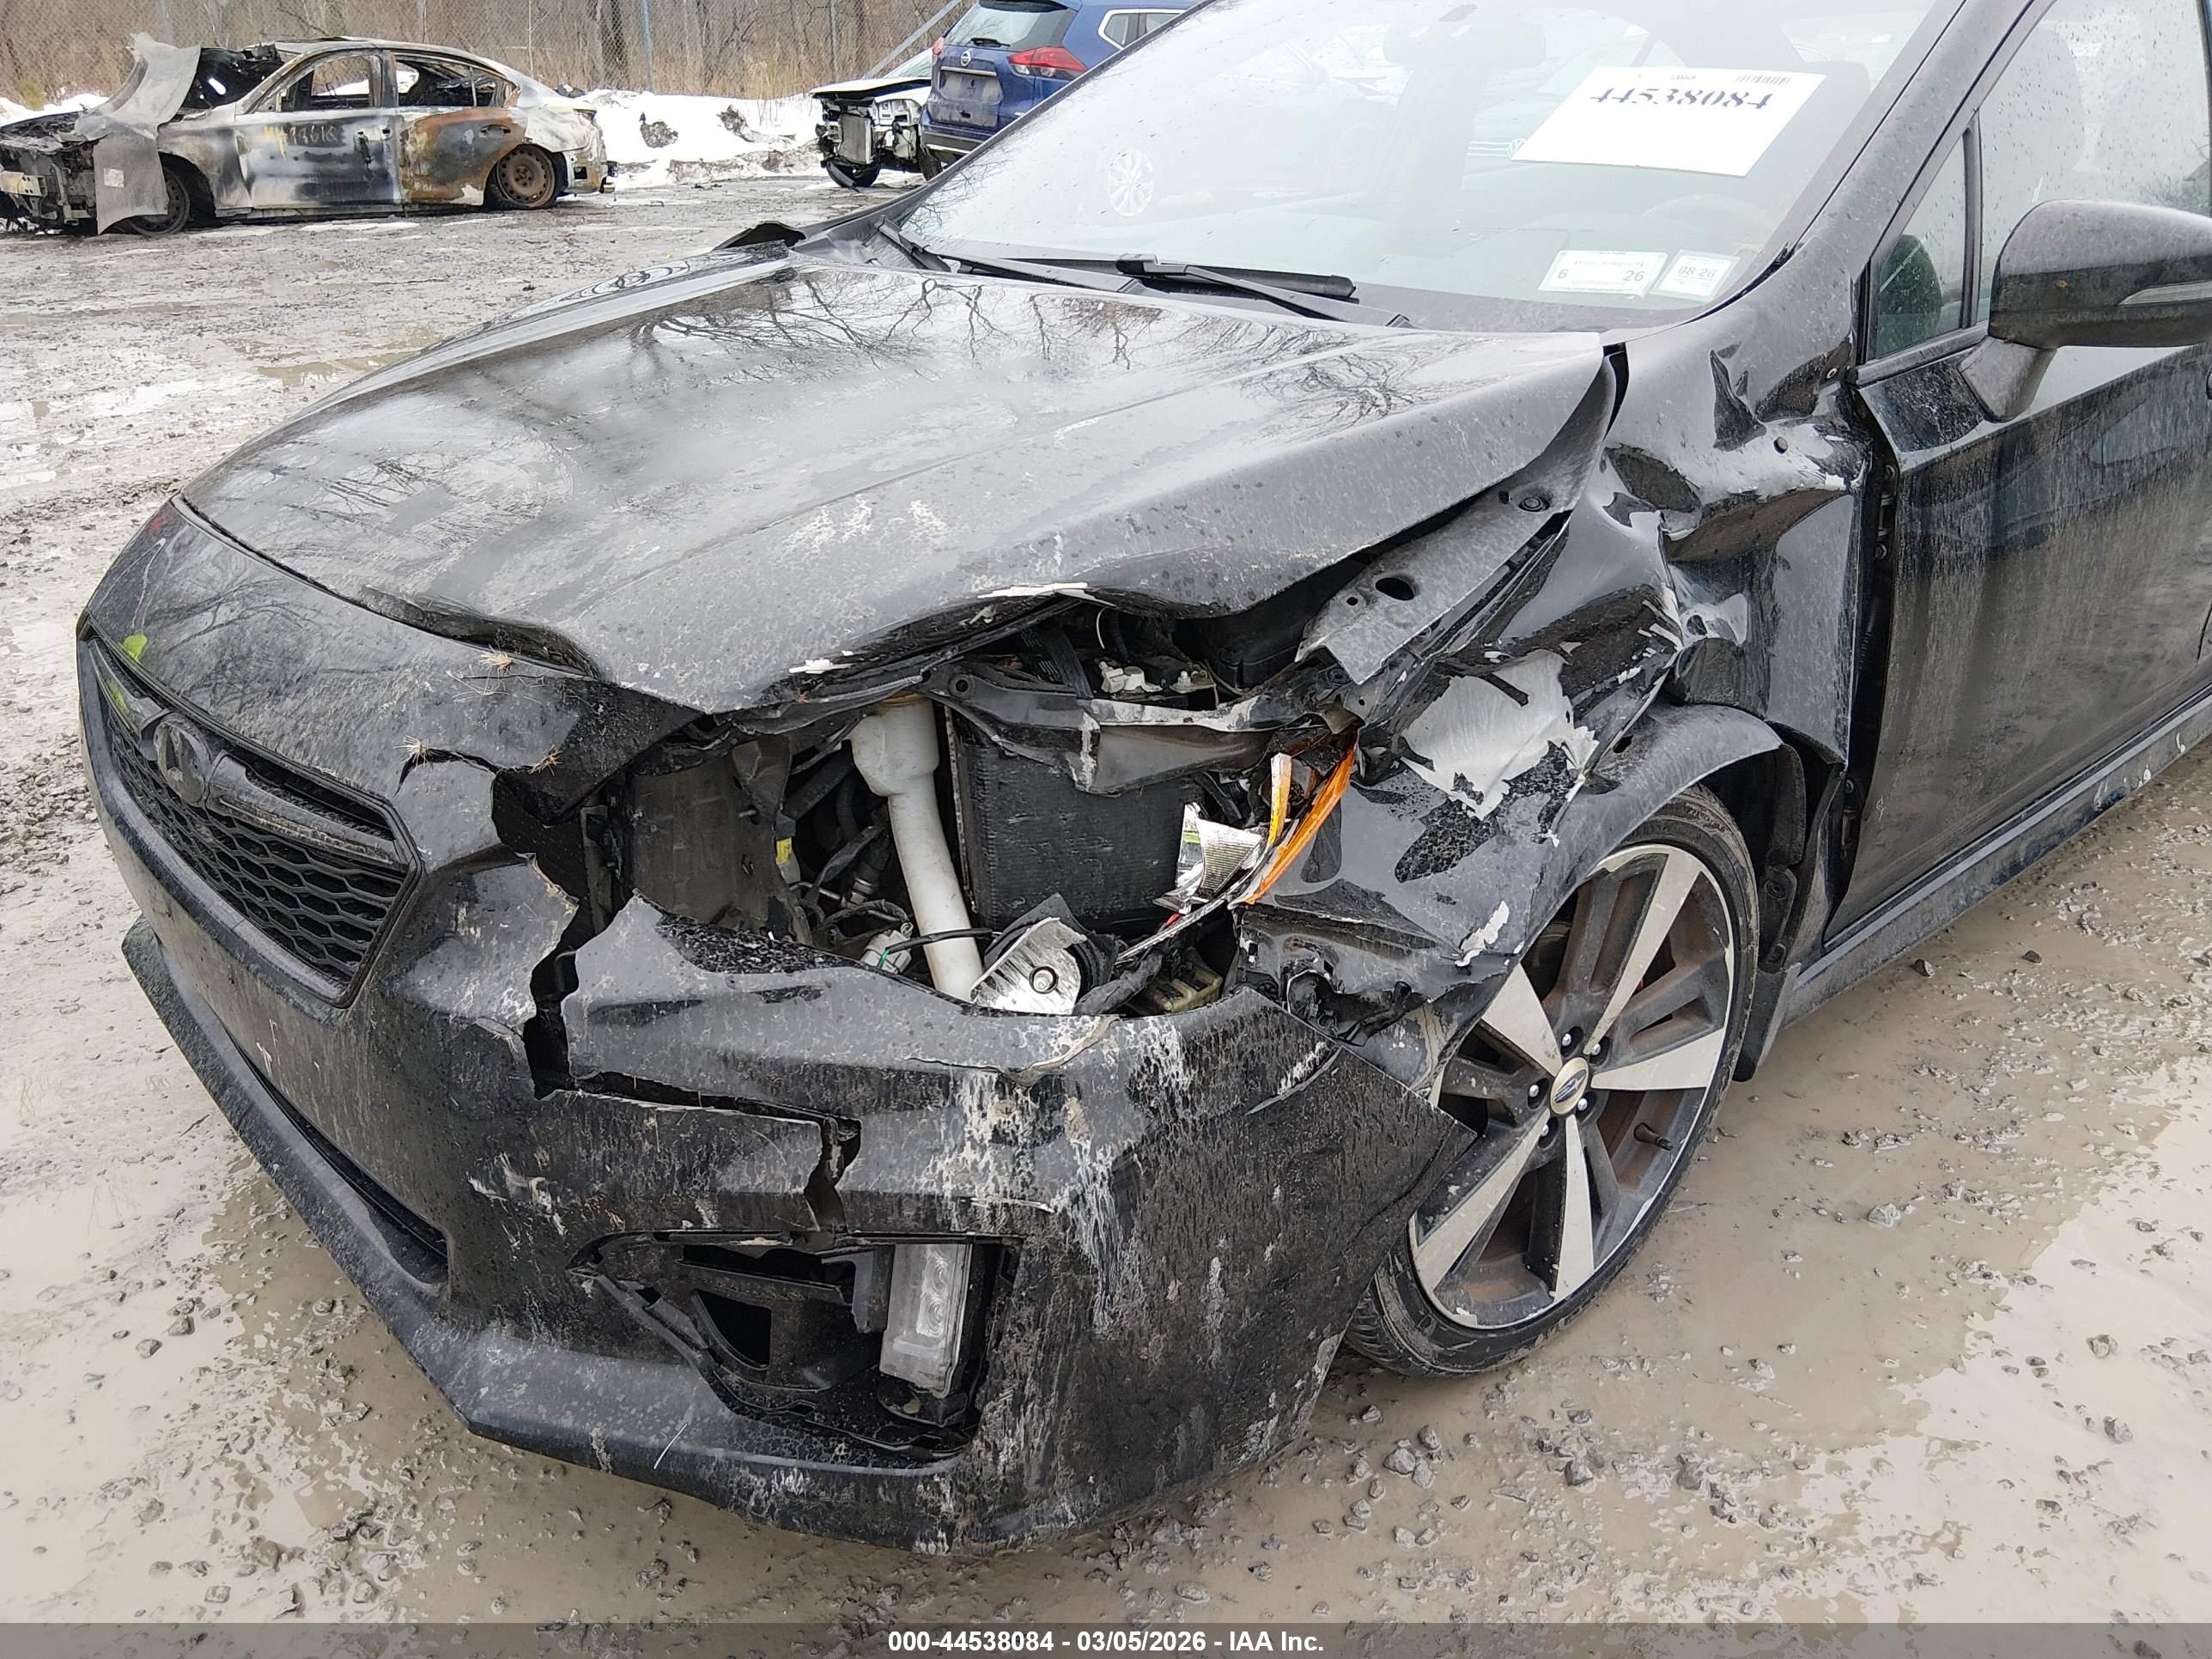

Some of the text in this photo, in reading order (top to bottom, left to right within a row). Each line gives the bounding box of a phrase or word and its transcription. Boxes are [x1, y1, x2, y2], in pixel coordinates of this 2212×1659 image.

[1590, 88, 1773, 109] 44538084
[1558, 268, 1645, 282] 6 26
[1677, 265, 1697, 276] 08
[1698, 268, 1717, 278] 26
